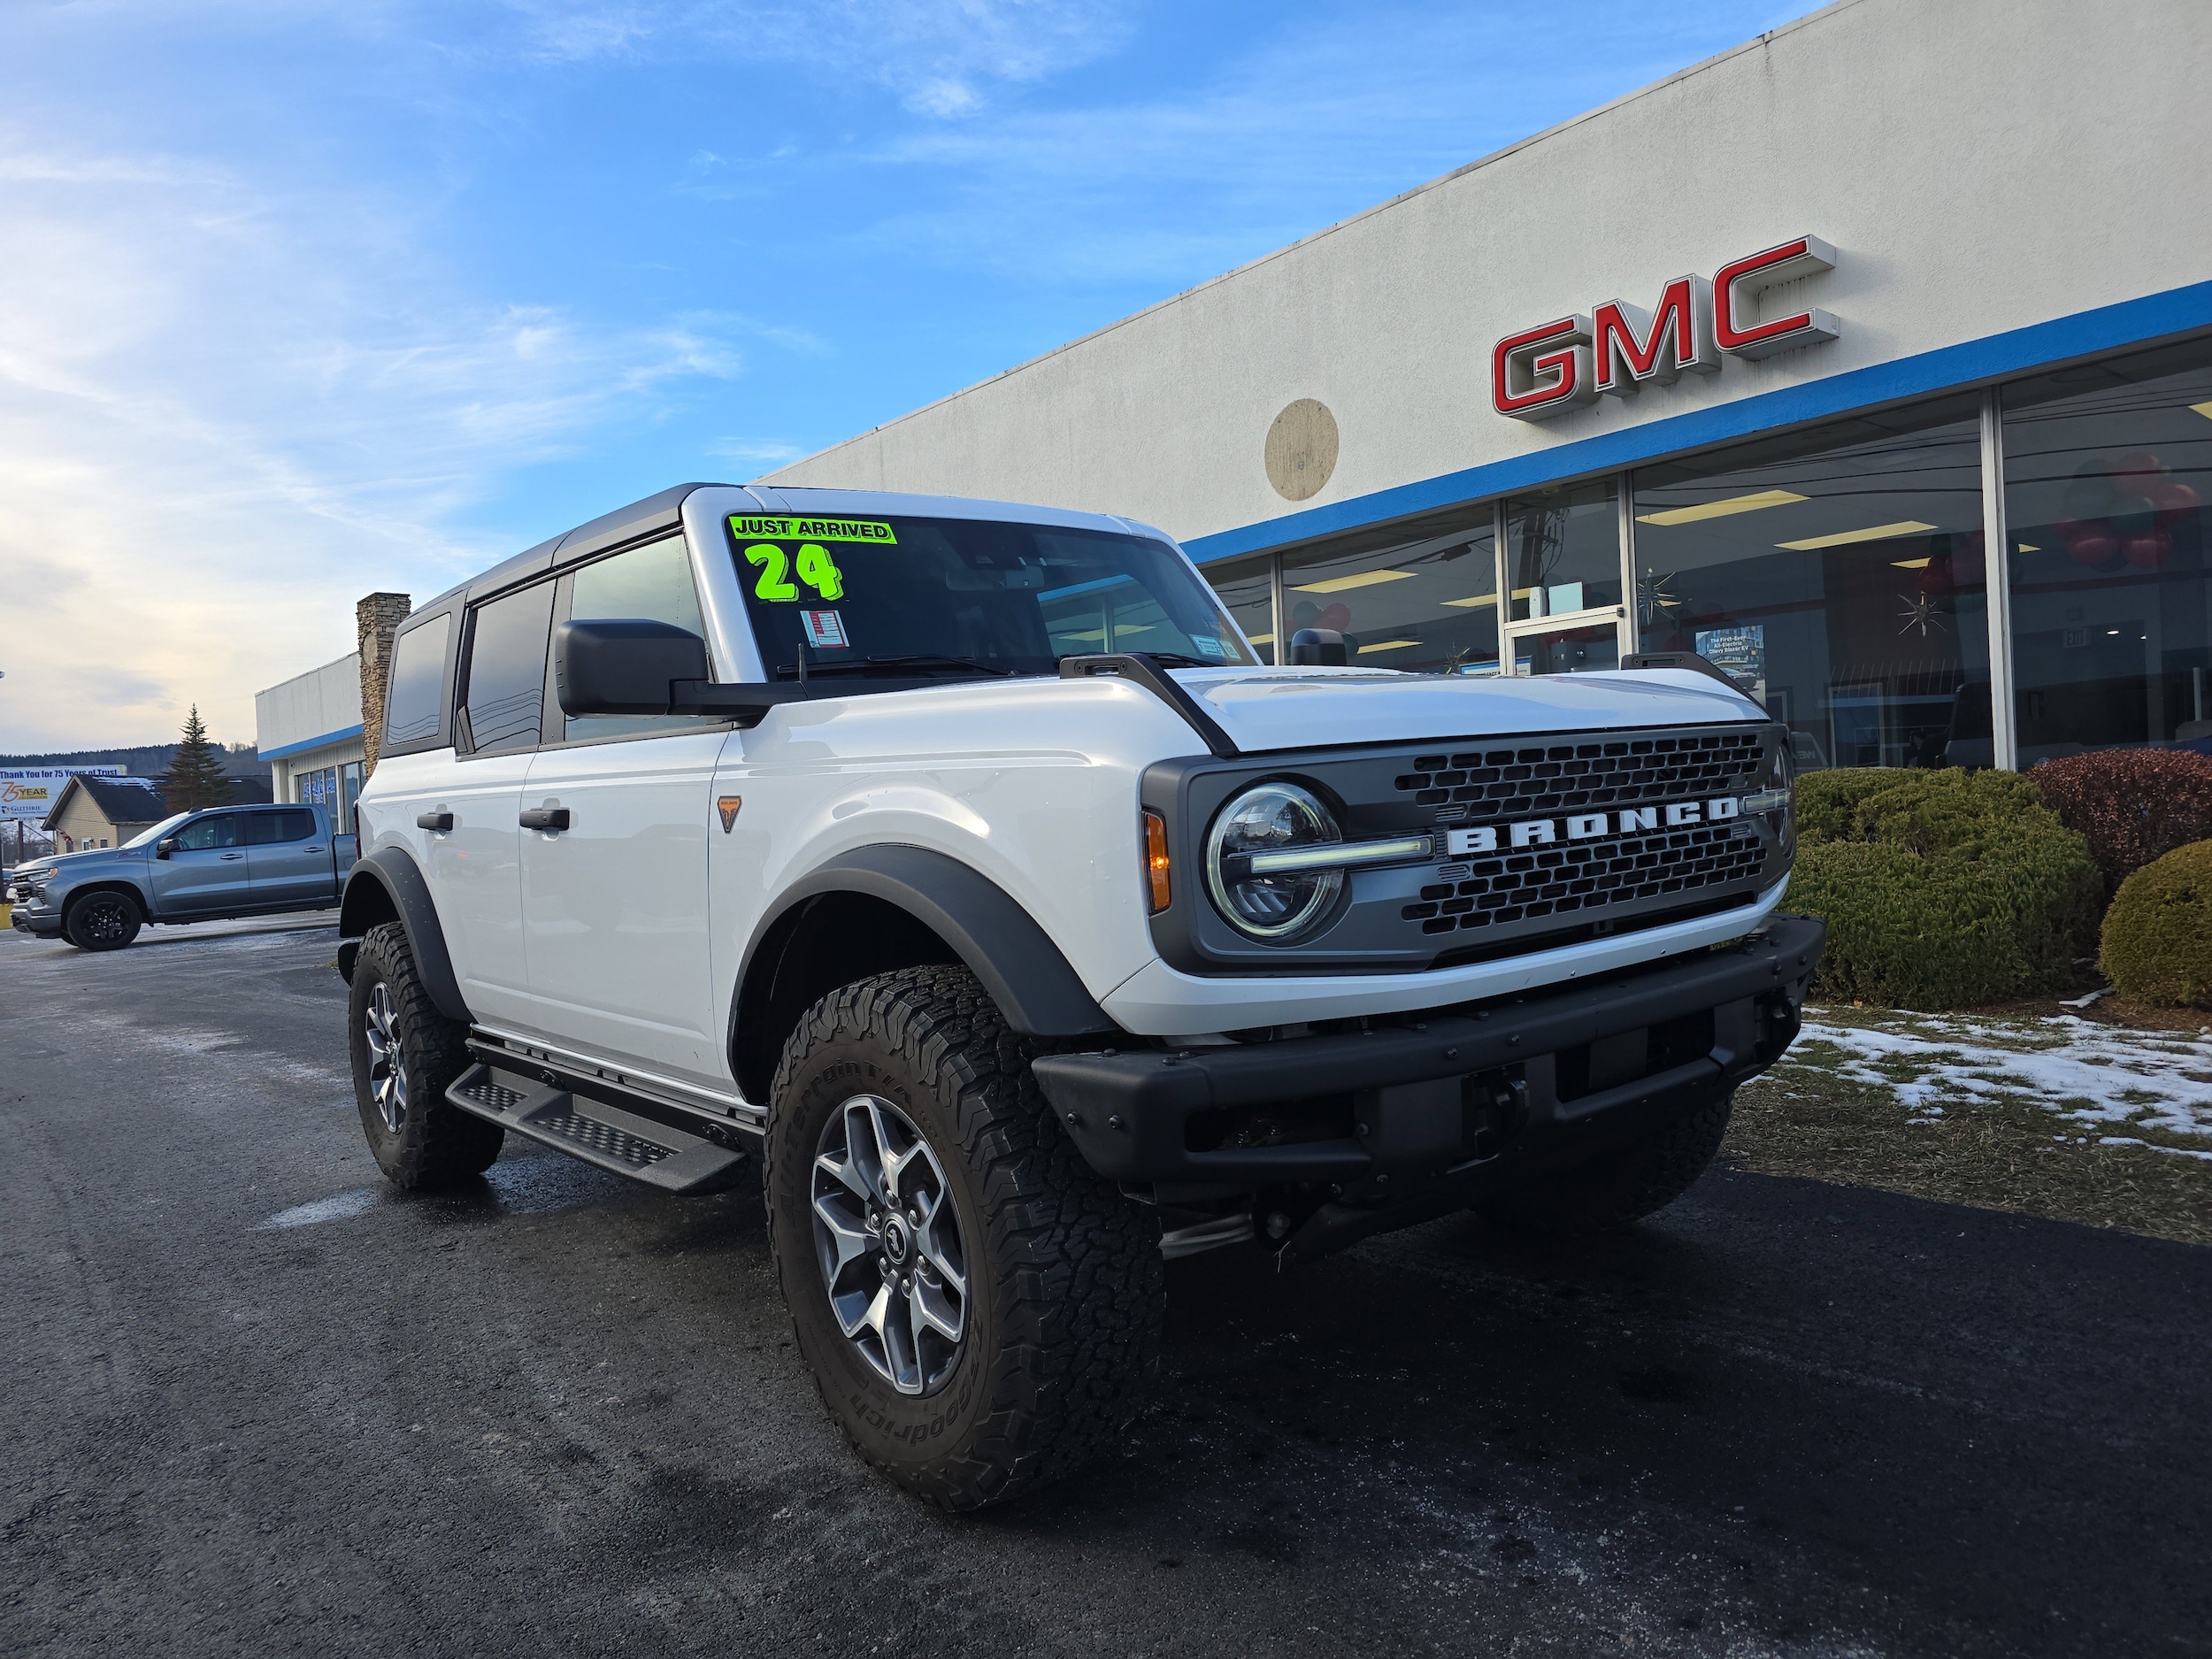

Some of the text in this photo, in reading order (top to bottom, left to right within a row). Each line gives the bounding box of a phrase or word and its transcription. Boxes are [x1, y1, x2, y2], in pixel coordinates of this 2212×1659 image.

[1492, 234, 1828, 416] GMC
[735, 519, 890, 539] JUST ARRIVED
[744, 543, 843, 601] 24
[2067, 630, 2083, 646] EXIT
[26, 770, 40, 779] You
[2, 781, 24, 803] 75
[19, 787, 47, 796] YEAR
[1446, 797, 1739, 856] BRONCO
